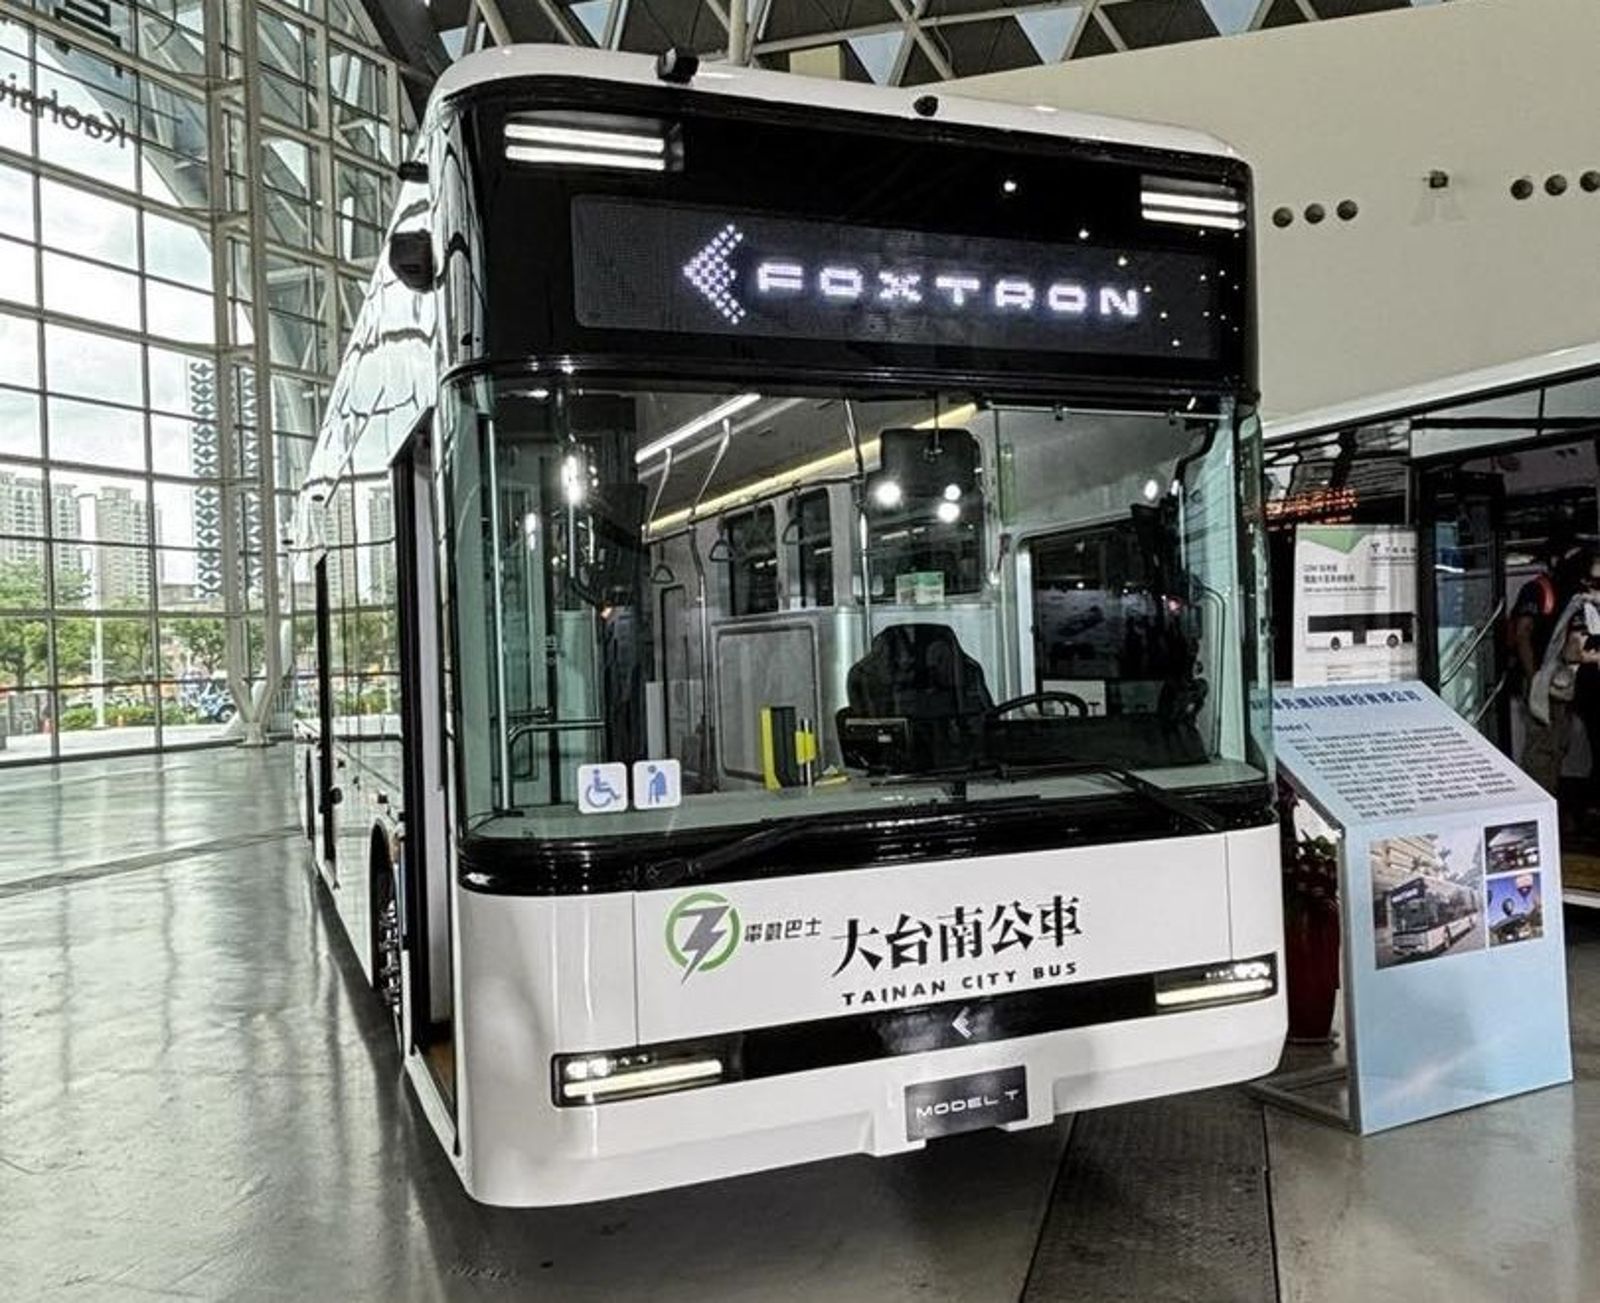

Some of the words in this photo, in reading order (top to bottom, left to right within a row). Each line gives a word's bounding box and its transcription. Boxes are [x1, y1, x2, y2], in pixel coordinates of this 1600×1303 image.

[757, 262, 1139, 316] FOXTRON
[831, 894, 1083, 978] 大台南公車
[842, 980, 946, 1006] TAINAN
[961, 969, 1017, 990] CITY
[1033, 962, 1077, 980] BUS
[916, 1095, 999, 1118] MODEL
[1004, 1089, 1019, 1101] T
